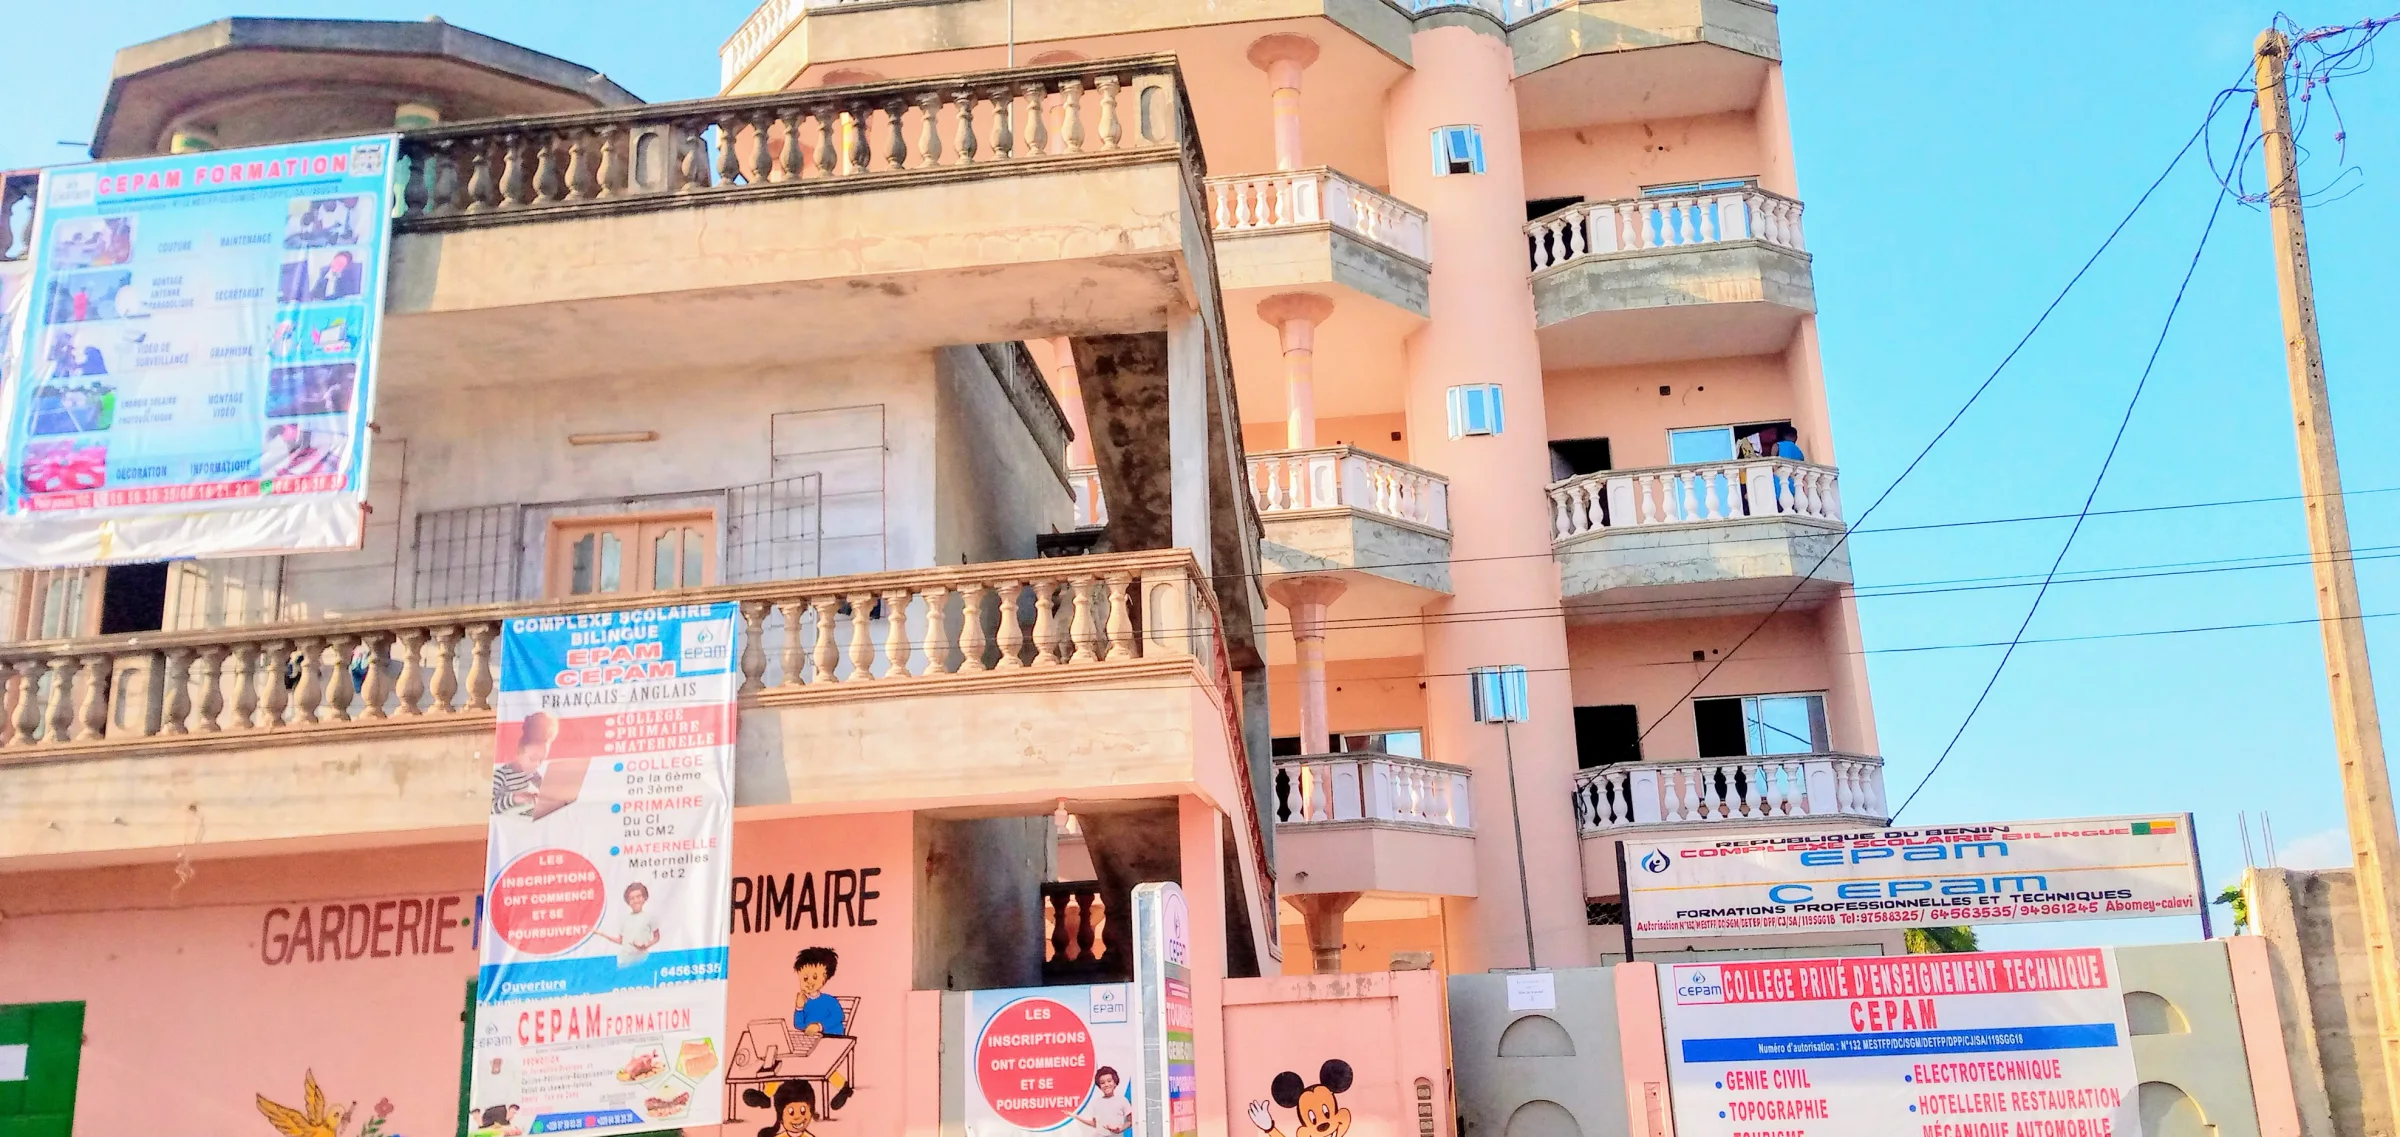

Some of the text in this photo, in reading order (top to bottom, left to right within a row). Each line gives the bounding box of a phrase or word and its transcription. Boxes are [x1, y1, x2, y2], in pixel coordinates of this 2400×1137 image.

[99, 168, 182, 195] CEPAM
[195, 153, 348, 186] FORMATION
[220, 232, 272, 247] MAINTENANCE
[135, 353, 189, 367] SURVEILLANCE
[210, 344, 253, 358] GRAPHISME
[208, 392, 243, 404] MONTAGE
[190, 458, 251, 476] INFORMATIQUE
[513, 605, 711, 634] COMPLEXE SCOLAIRE
[570, 625, 659, 646] BILINGUE
[566, 642, 663, 666] EPAM
[555, 660, 676, 687] CEPAM
[616, 708, 684, 727] COLLEGE
[616, 721, 700, 740] PRIMAIRE
[614, 733, 715, 754] MATERNELLE
[626, 755, 704, 773] COLLEGE
[626, 770, 702, 784] De la 6ème
[628, 783, 683, 795] en 3ème
[622, 795, 703, 813] PRIMAIRE
[623, 814, 660, 827] Du CI
[624, 825, 675, 838] au CM2
[1716, 825, 2010, 848] REPUBLIQUE DU BENIN
[623, 837, 717, 856] MATERNELLE
[1680, 828, 2131, 859] COMPLEXE SCOLAIRE BILINGUE
[539, 854, 564, 867] LES
[628, 852, 709, 869] Maternelles
[502, 871, 596, 889] INSCRIPTIONS
[503, 888, 595, 907] ONT COMMENCÉ
[730, 867, 881, 934] RIMAIRE
[1677, 889, 2132, 919] FORMATIONS PROFESSIONNELLES ET TECHNIQUES
[532, 908, 564, 921] ET SE
[1637, 920, 1679, 932] Autorisation
[2106, 894, 2194, 912] Abomey-calavi
[261, 896, 461, 965] GARDERIE
[508, 924, 589, 941] POURSUIVENT
[660, 963, 722, 978] 64563535
[1723, 955, 2101, 1001] COLLEGE PRIVÉ D'ENSEIGNEMENT TECHNIQUE
[501, 979, 566, 994] Ouverture
[1025, 1008, 1051, 1021] LES
[1850, 998, 1938, 1032] CEPAM
[517, 1004, 601, 1046] CEPAM
[606, 1008, 691, 1036] FORMATION
[988, 1032, 1086, 1048] INSCRIPTIONS
[1758, 1043, 1785, 1054] Numéro
[1787, 1041, 1835, 1052] d'autorisation
[991, 1053, 1086, 1071] ONT COMMENCÉ
[1726, 1068, 1811, 1091] GENIE CIVIL
[1914, 1059, 2062, 1084] ELECTROTECHNIQUE
[1020, 1078, 1054, 1091] ET SE
[996, 1095, 1080, 1111] POURSUIVENT
[1729, 1099, 1828, 1121] TOPOGRAPHIE
[1919, 1087, 2121, 1115] HOTELLERIE RESTAURATION
[1923, 1117, 2111, 1137] MÉCANIQUE AUTOMOBILE
